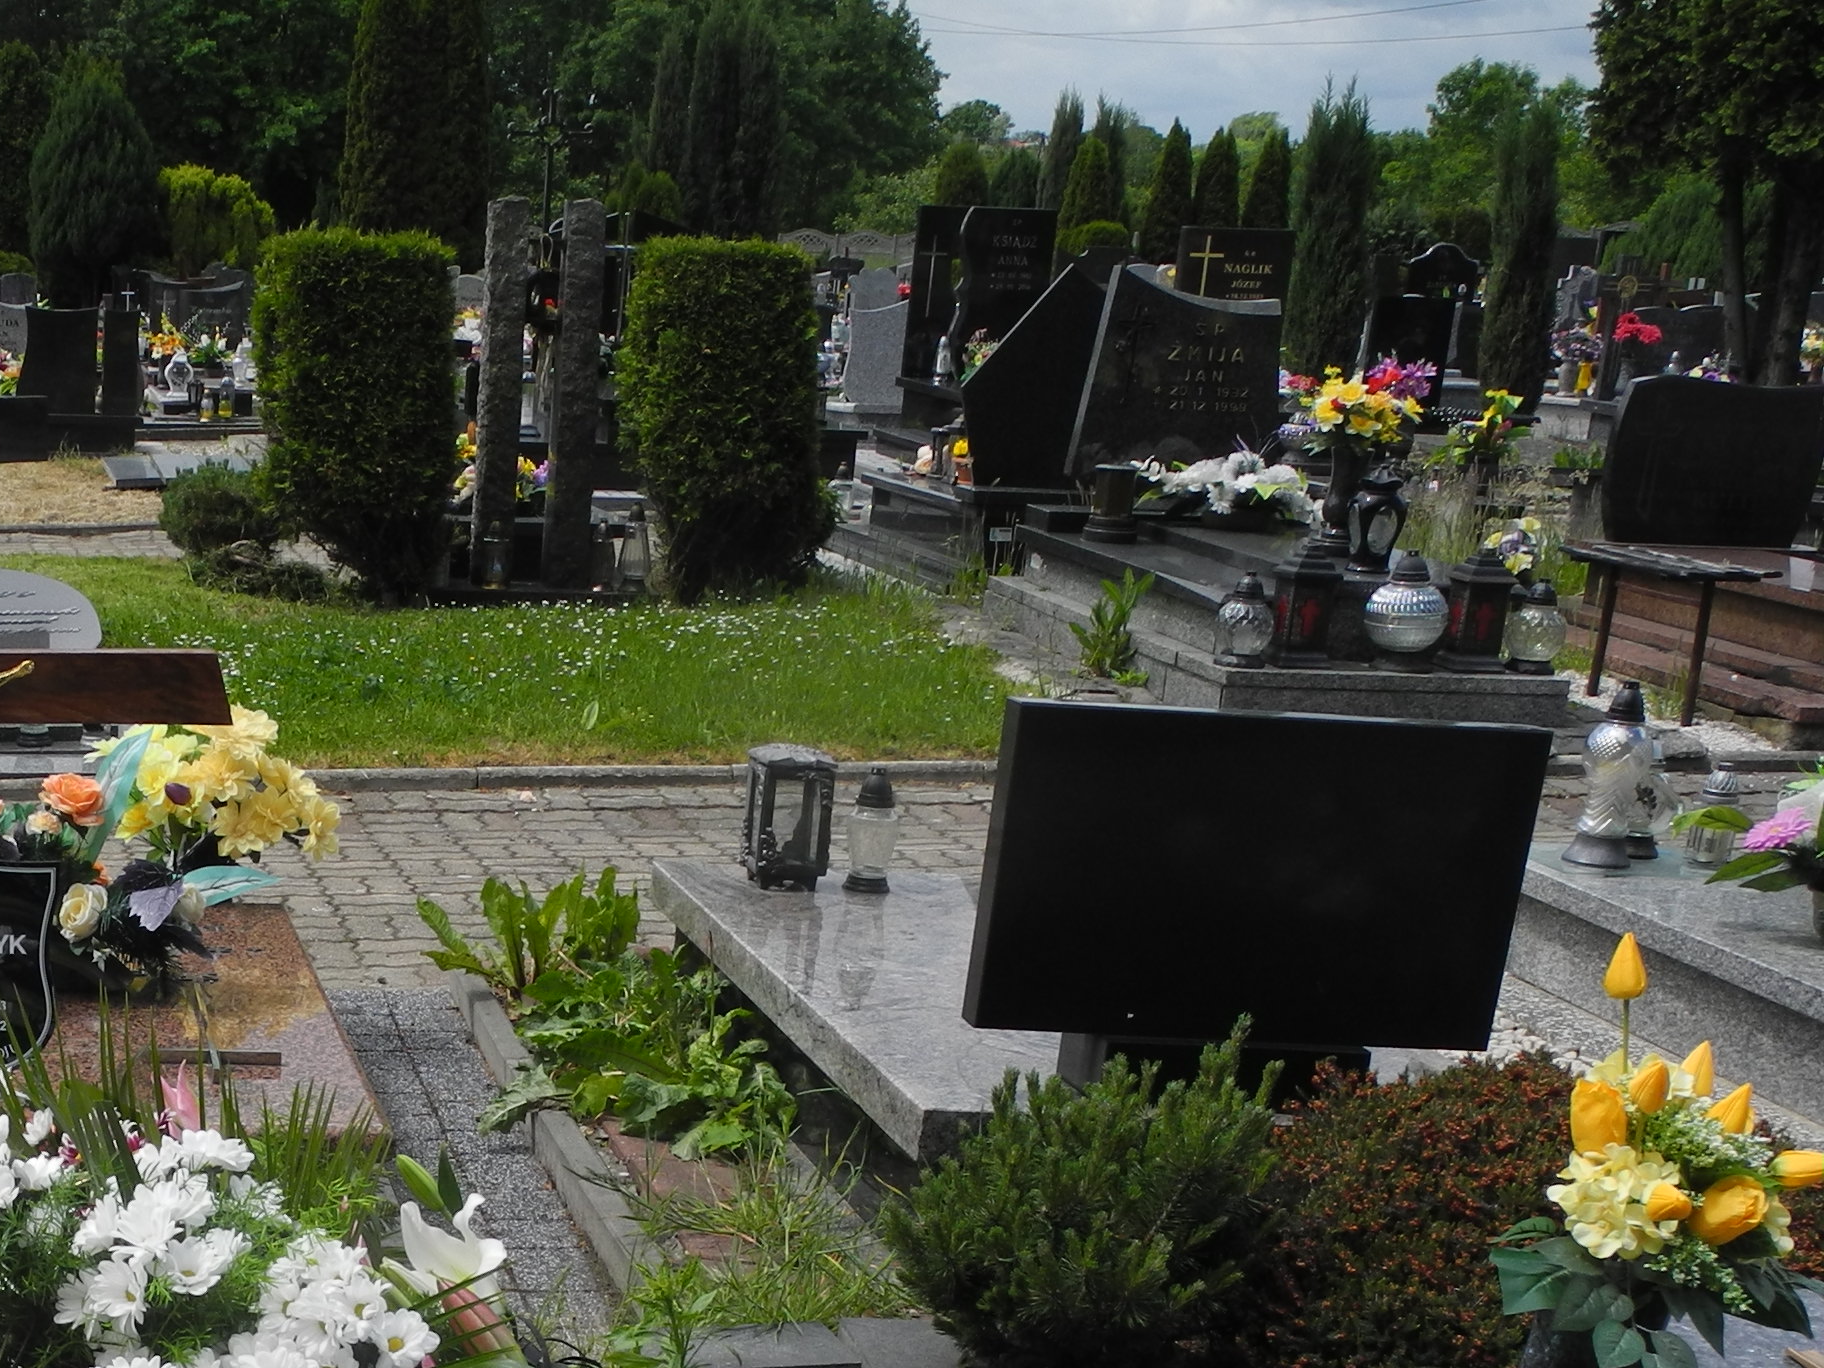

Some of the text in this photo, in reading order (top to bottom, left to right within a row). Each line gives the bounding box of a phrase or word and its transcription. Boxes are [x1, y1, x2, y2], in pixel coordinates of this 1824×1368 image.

[997, 255, 1028, 266] ANNA
[1223, 263, 1273, 274] NAGLIK
[1230, 279, 1263, 289] JÓZEF
[1167, 340, 1245, 363] ŻMIJA
[1185, 369, 1224, 383] JAN
